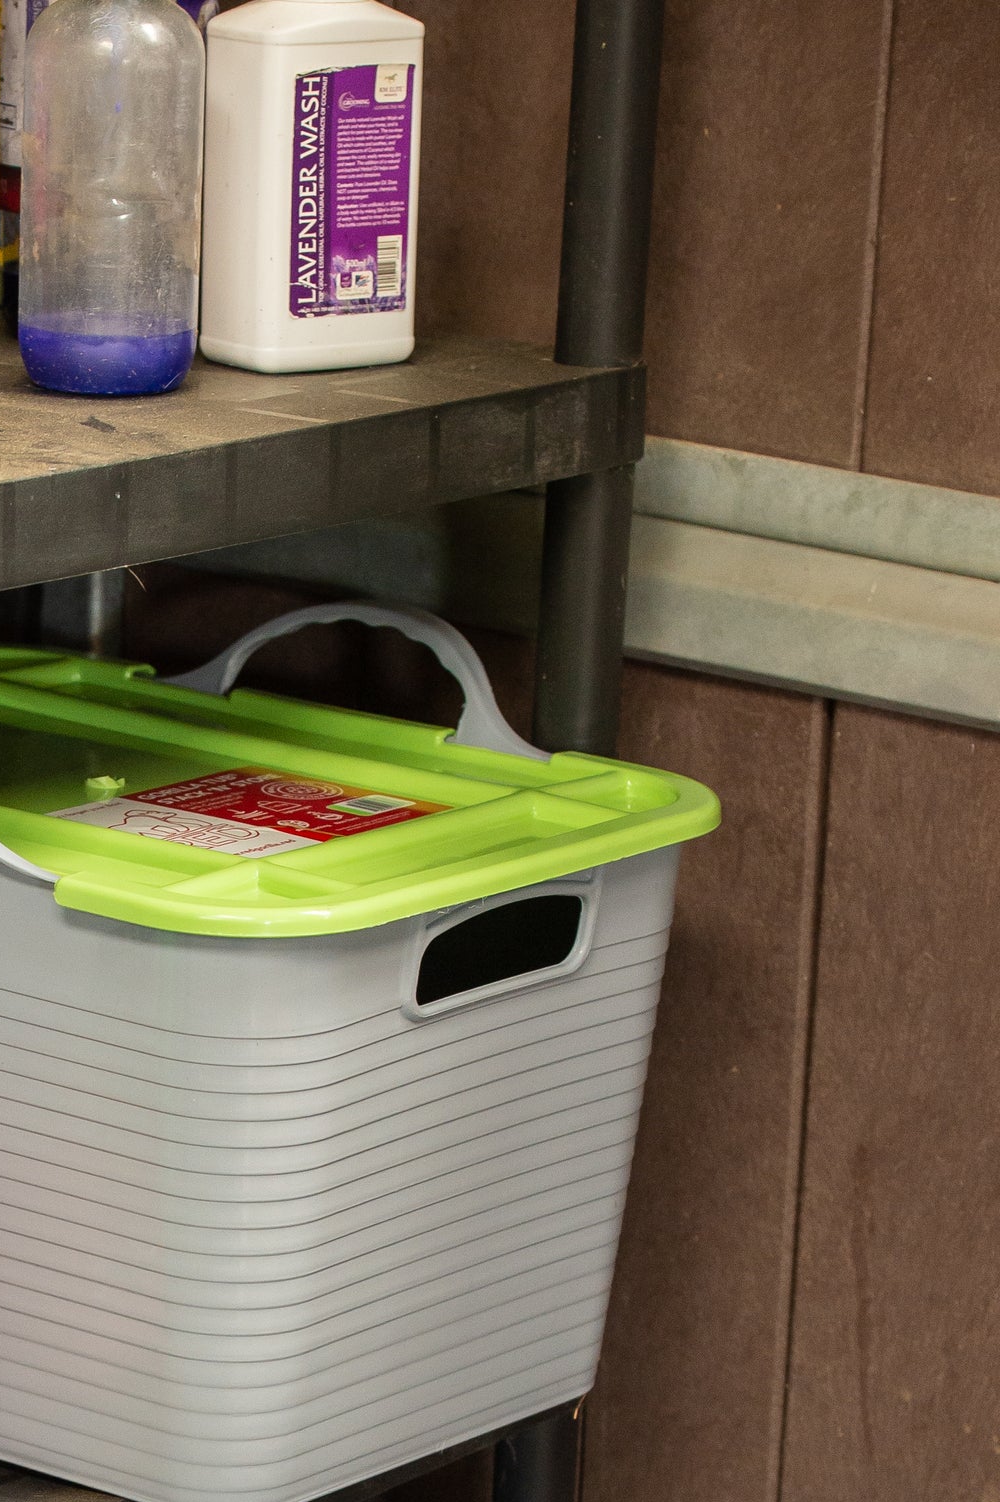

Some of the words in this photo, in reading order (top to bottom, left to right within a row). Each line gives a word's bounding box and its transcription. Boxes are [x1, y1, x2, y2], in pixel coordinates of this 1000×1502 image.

[300, 76, 321, 159] WASH
[298, 163, 317, 303] LAVENDER
[138, 783, 205, 800] GORILLA
[157, 791, 214, 804] STACK
